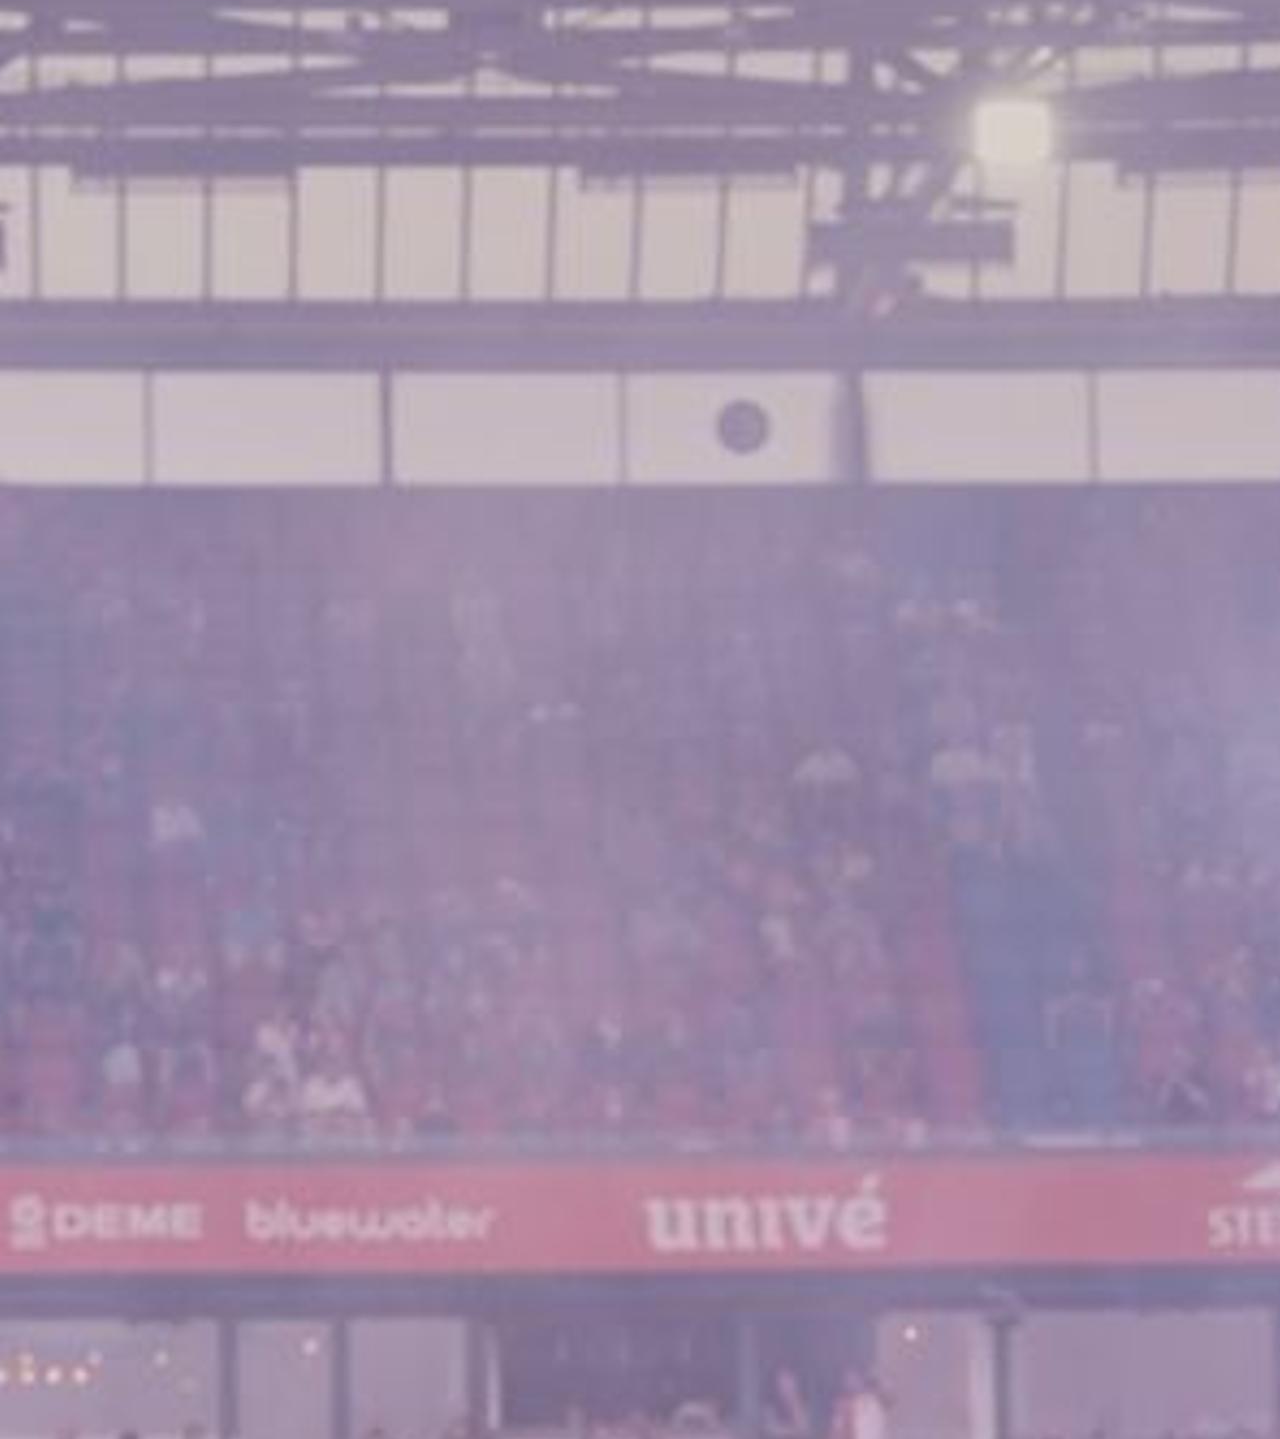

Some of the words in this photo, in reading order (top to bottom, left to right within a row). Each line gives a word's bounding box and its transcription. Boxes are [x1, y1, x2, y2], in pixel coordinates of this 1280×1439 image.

[53, 1202, 203, 1242] DEME
[244, 1197, 497, 1243] bluewater
[644, 1172, 888, 1251] univé
